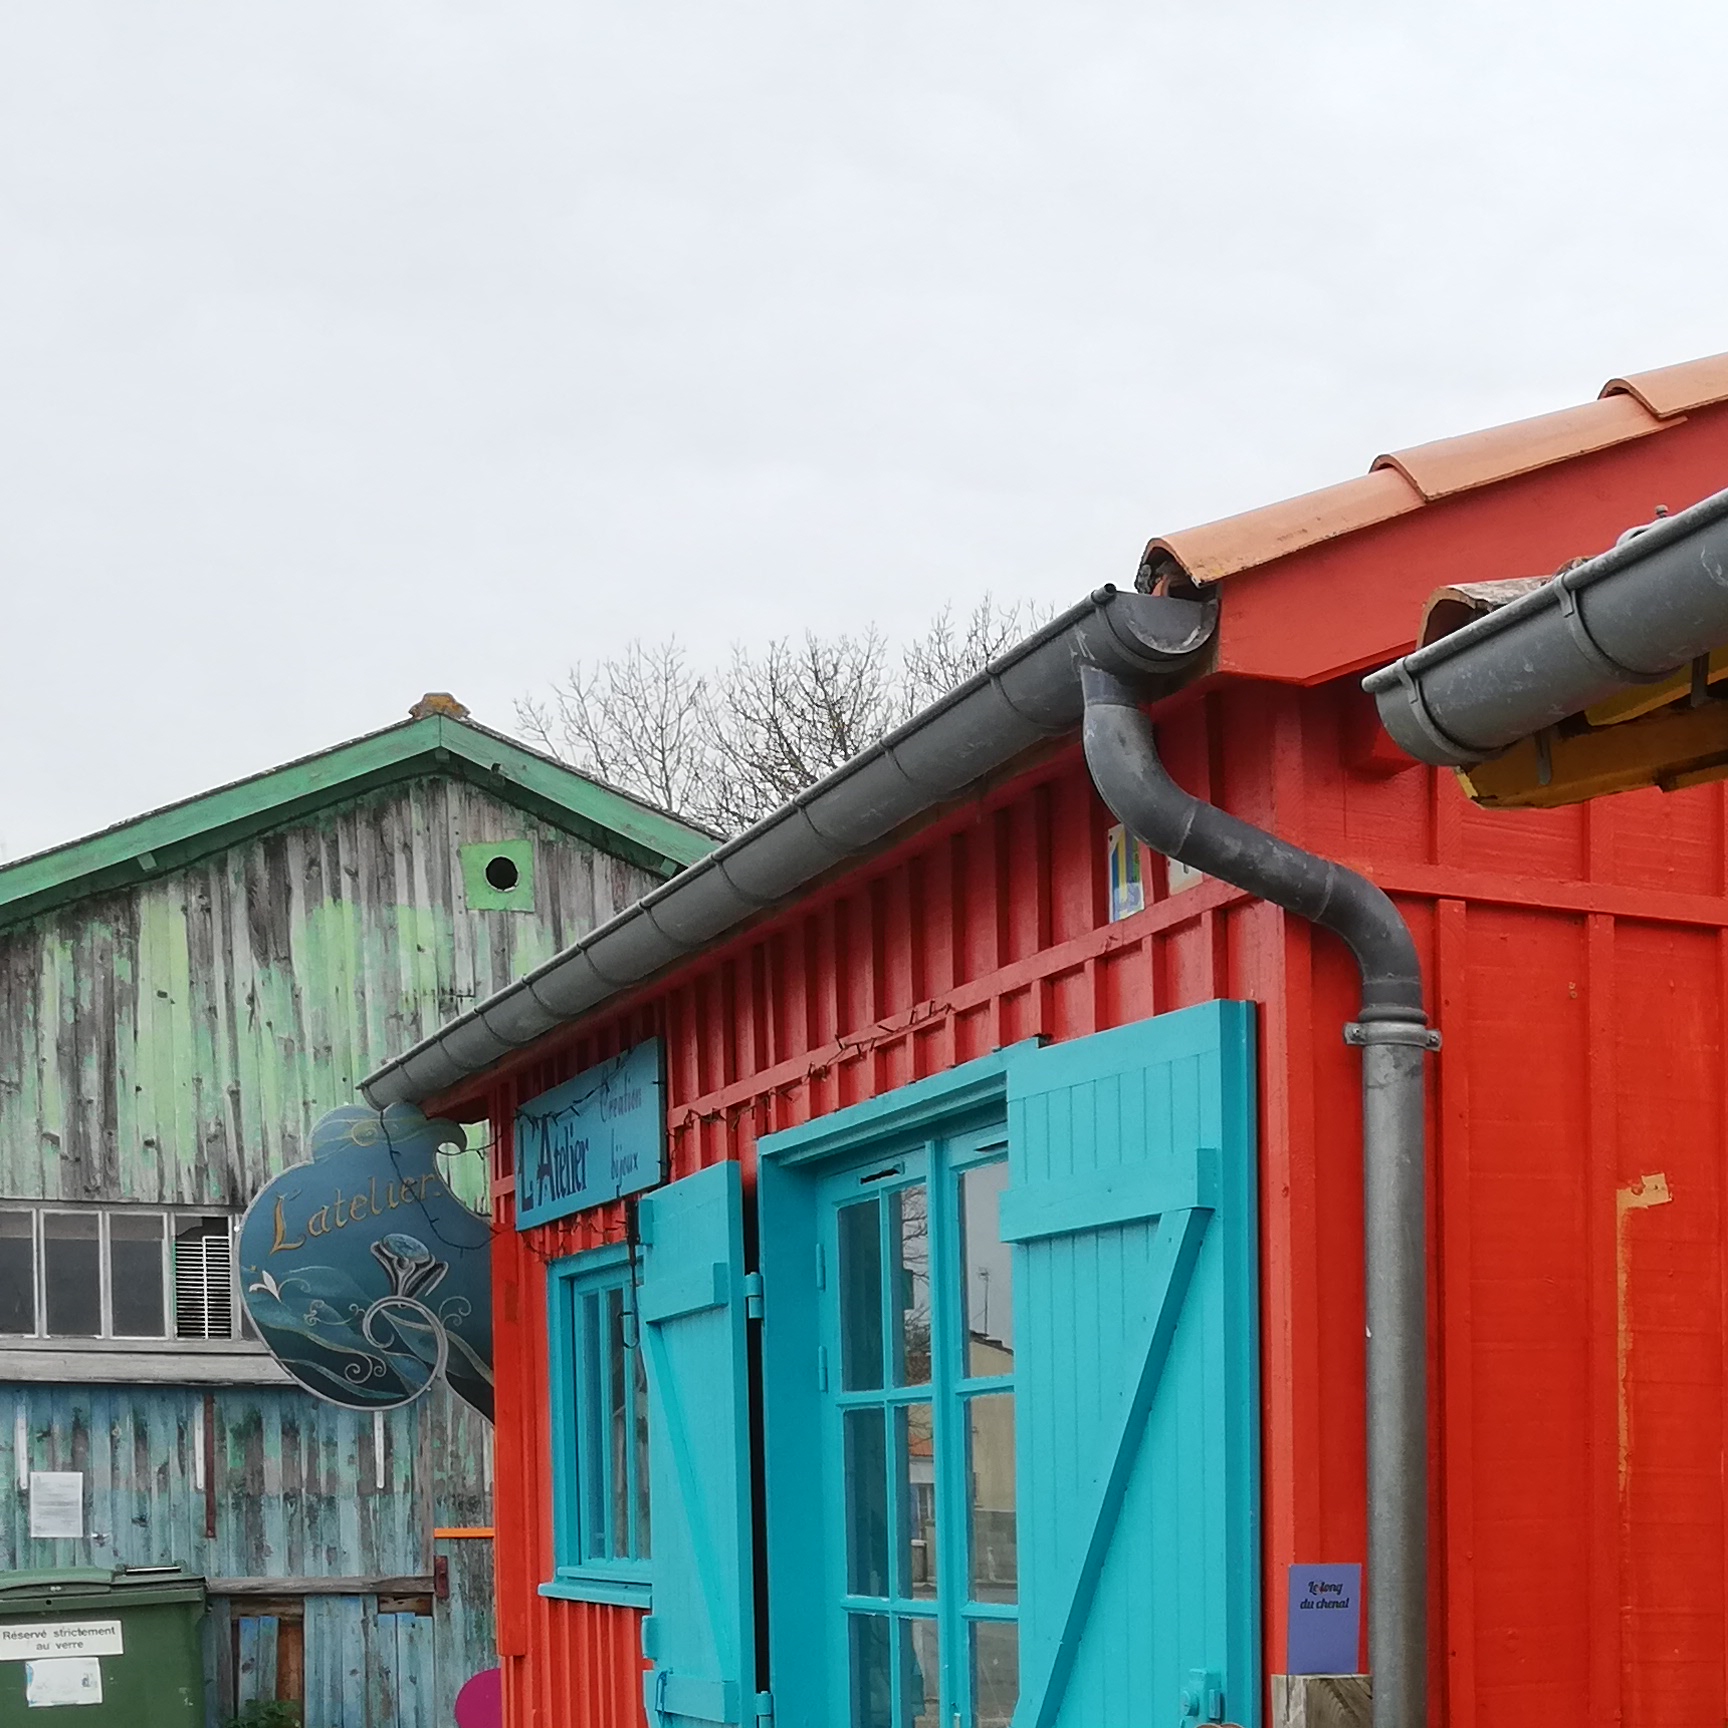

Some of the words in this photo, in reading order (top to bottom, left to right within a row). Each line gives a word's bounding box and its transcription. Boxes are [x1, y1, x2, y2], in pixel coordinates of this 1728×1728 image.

[610, 1127, 639, 1189] bijoux
[1308, 1581, 1318, 1596] Le
[1319, 1581, 1343, 1596] long
[1300, 1598, 1314, 1609] du
[1316, 1597, 1350, 1609] chenal
[2, 1629, 47, 1640] Réservé
[53, 1626, 116, 1638] strictement
[36, 1642, 50, 1651] au
[55, 1641, 84, 1650] verre
